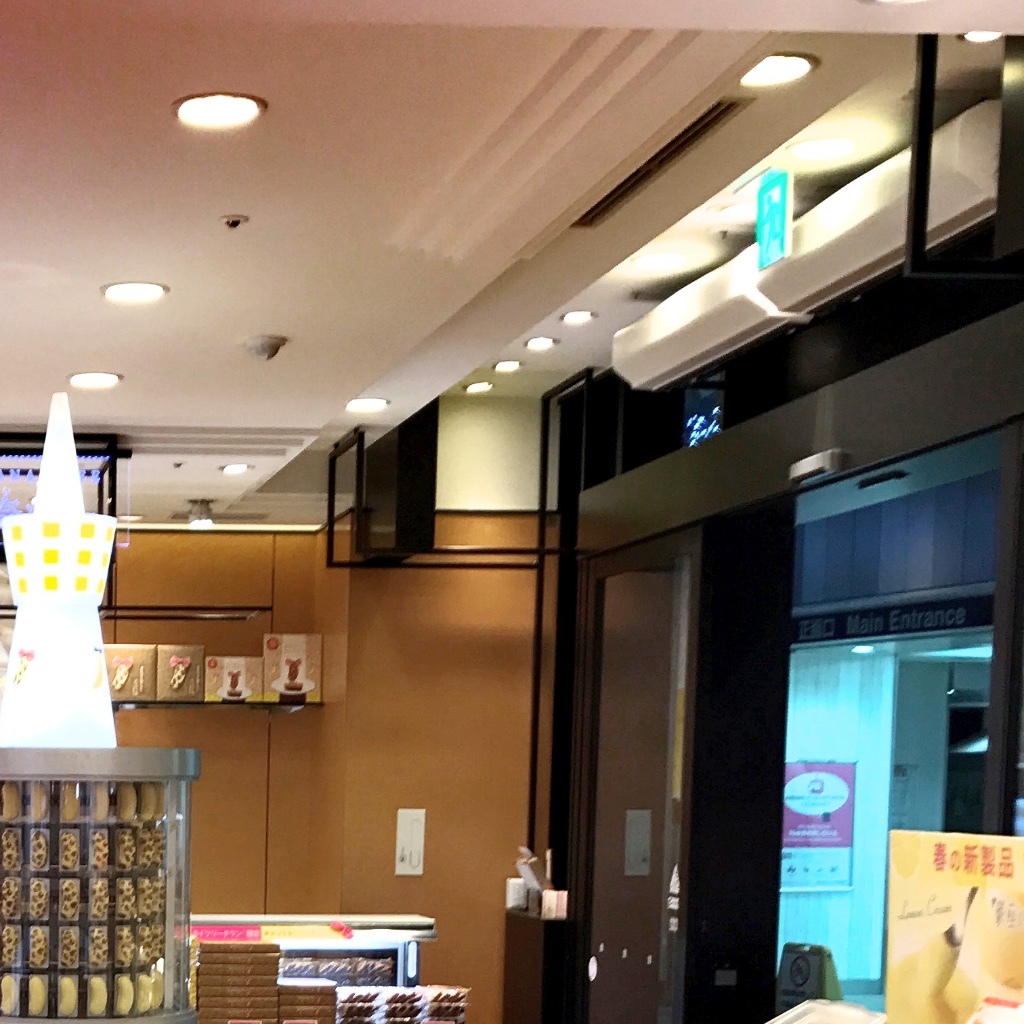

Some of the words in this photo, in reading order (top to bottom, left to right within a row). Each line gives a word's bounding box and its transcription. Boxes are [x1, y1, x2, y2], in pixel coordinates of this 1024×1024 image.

[847, 614, 884, 635] Main
[889, 606, 967, 632] Entrance
[934, 841, 1015, 879] 春の新製品
